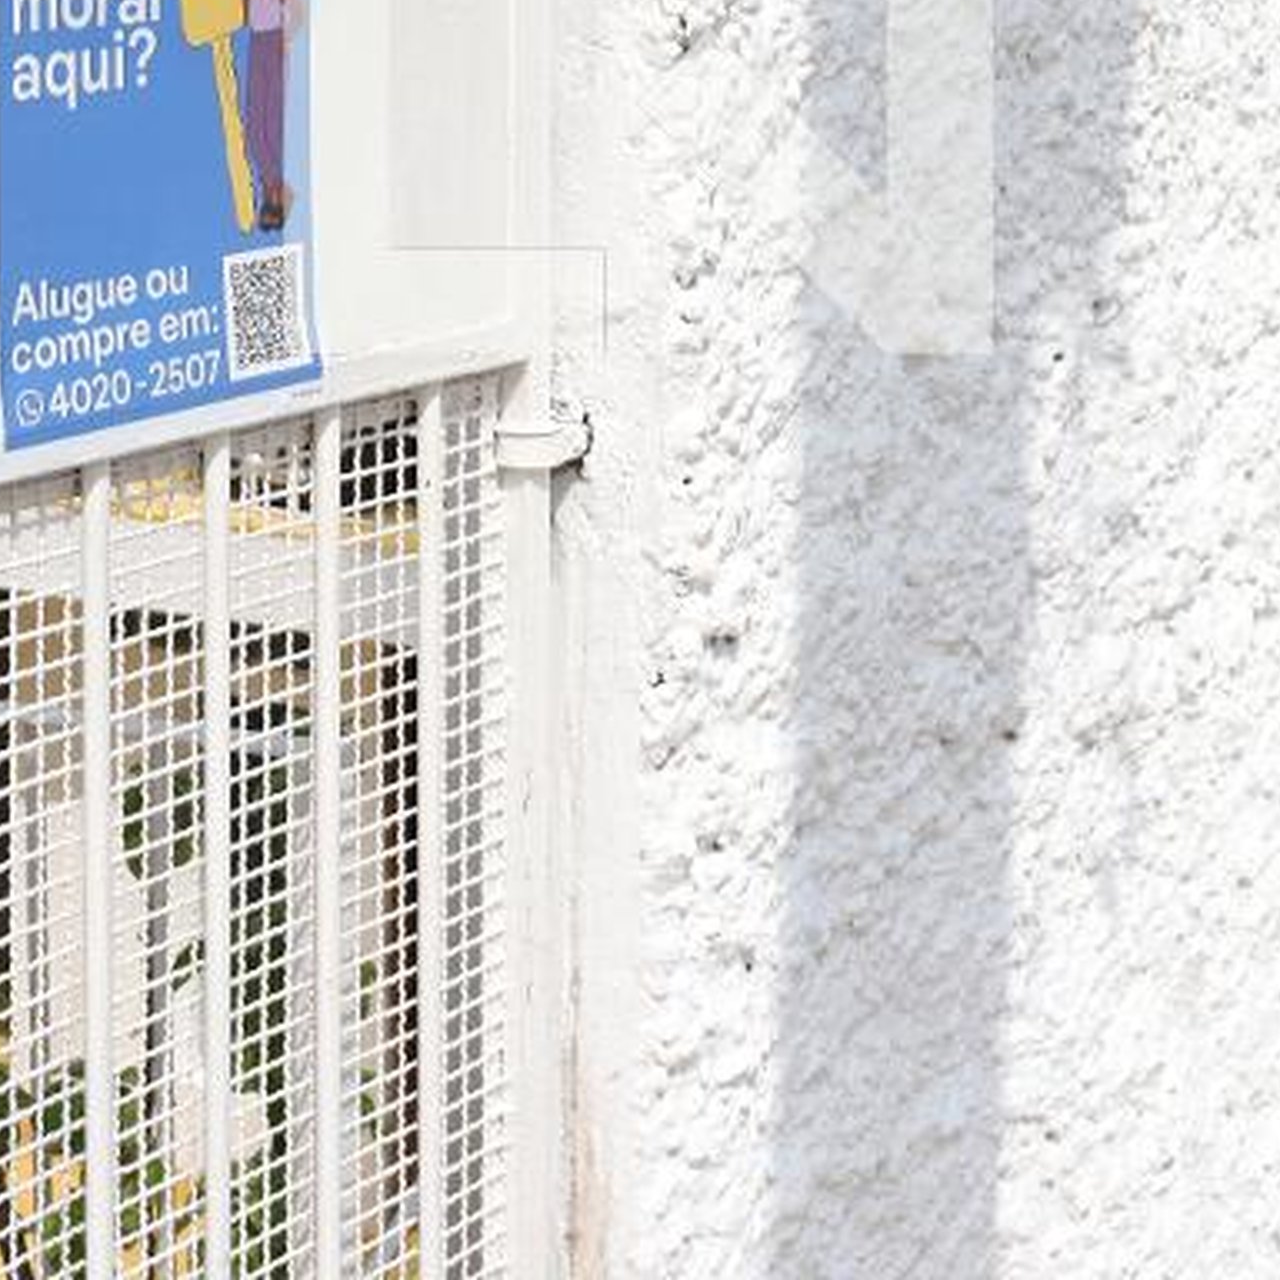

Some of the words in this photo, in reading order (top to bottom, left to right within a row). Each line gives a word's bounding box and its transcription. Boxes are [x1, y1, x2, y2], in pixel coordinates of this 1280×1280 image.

[12, 27, 157, 109] aqui?
[12, 273, 137, 325] Alugue
[145, 266, 188, 299] ou
[11, 319, 150, 373] compre
[158, 303, 220, 343] em:
